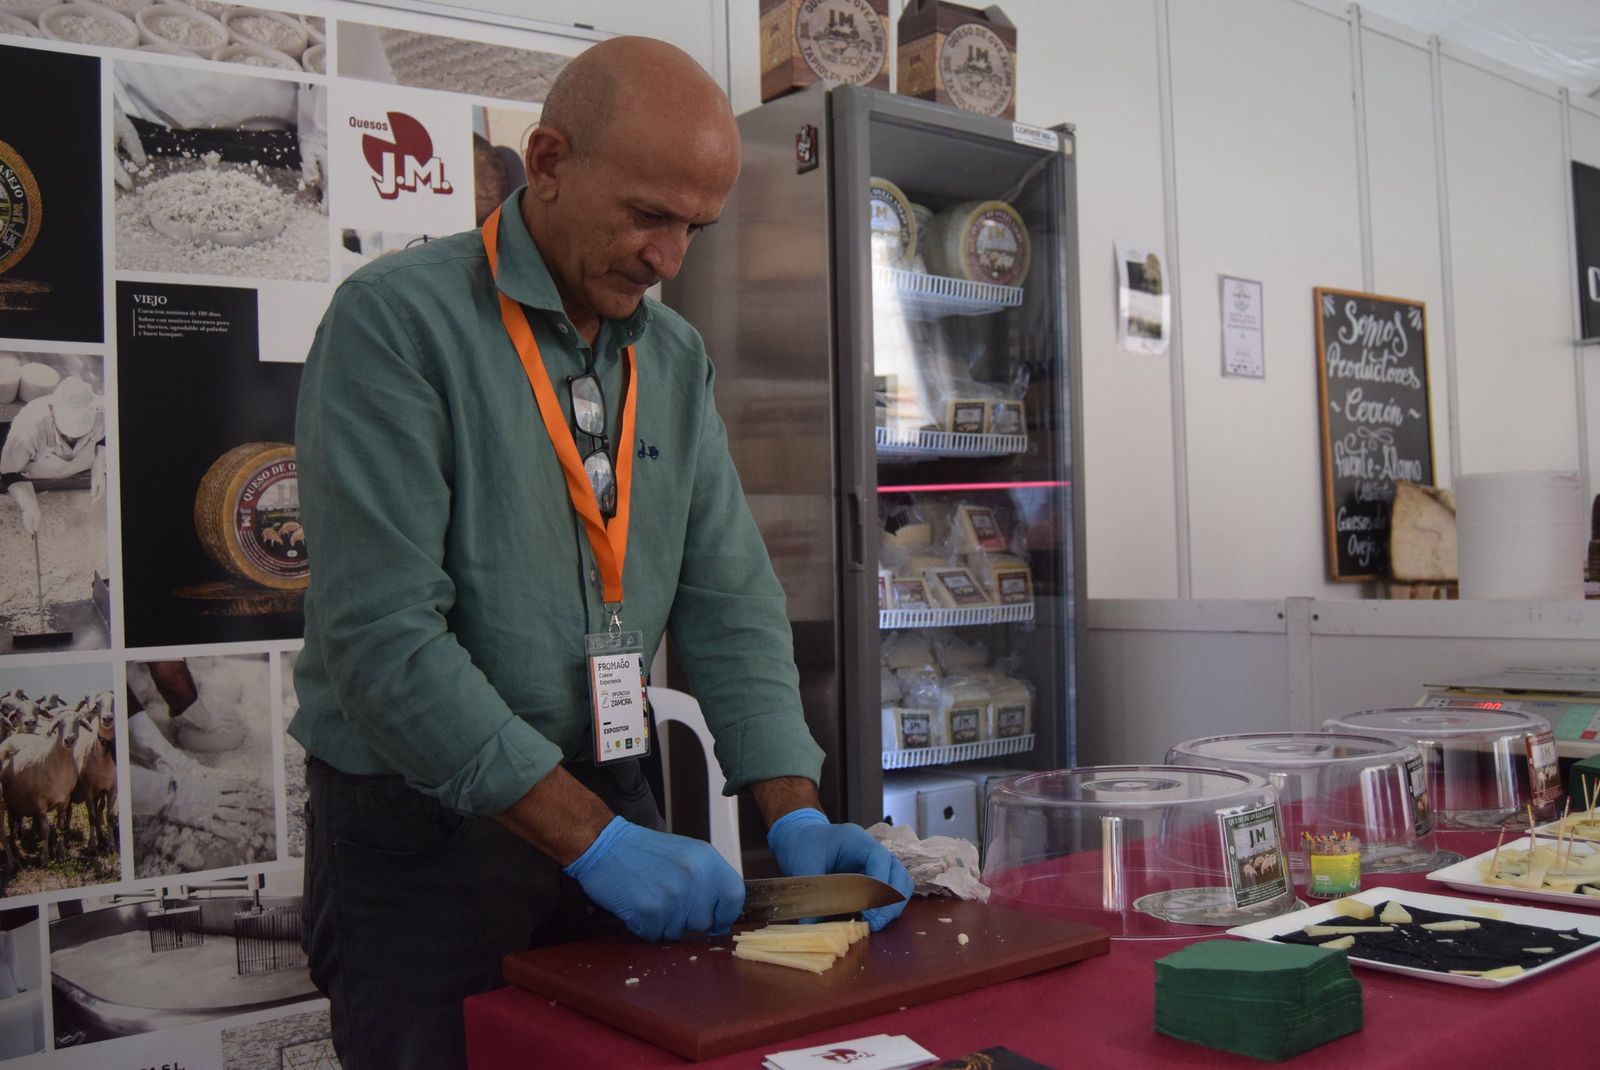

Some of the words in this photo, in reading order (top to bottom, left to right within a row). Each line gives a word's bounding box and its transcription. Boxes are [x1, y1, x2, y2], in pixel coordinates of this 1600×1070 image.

[349, 116, 388, 131] Quesos
[371, 151, 454, 200] J.M.
[133, 294, 168, 306] VIEJO
[1338, 300, 1408, 357] Somos
[1326, 341, 1421, 389] Productores
[243, 470, 271, 502] QUESO
[271, 463, 287, 475] DE
[610, 698, 633, 707] ZAMORA
[603, 725, 630, 735] EXPOSITOR
